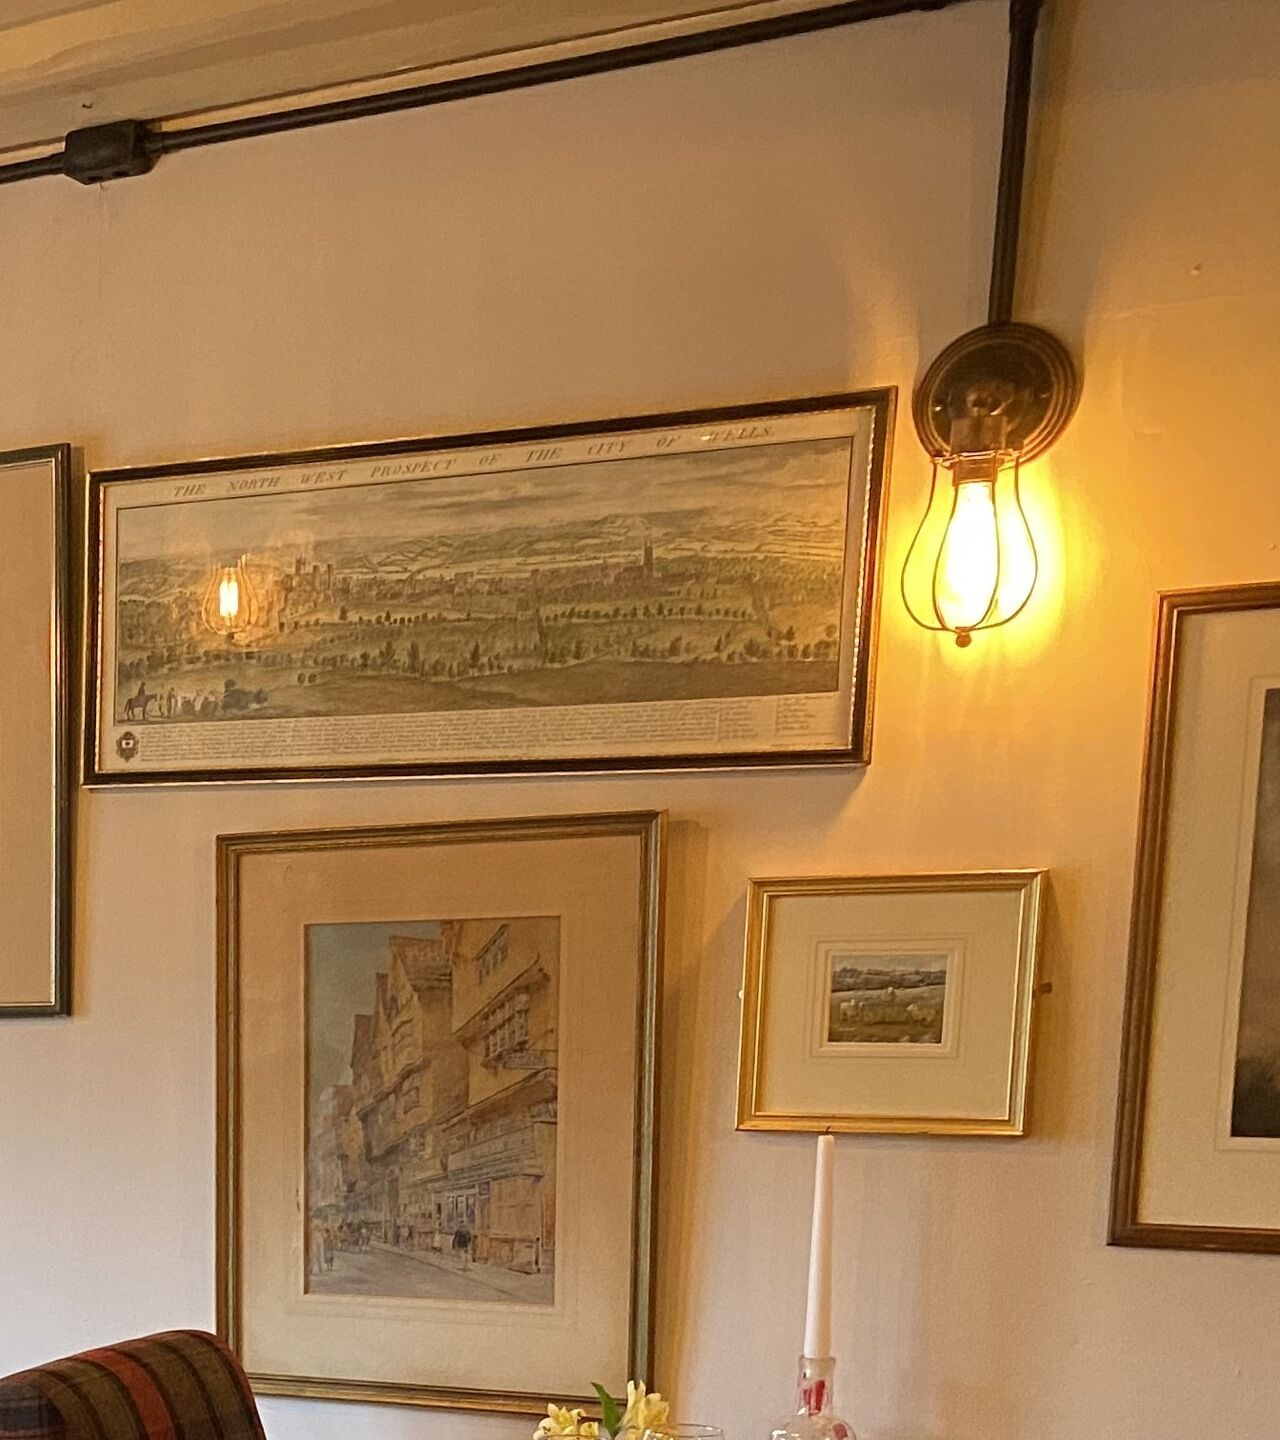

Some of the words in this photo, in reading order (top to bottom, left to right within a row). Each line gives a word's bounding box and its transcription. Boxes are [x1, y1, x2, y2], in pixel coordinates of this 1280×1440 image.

[173, 483, 207, 498] THE
[226, 475, 281, 492] NORTH
[300, 469, 348, 485] WEST
[370, 458, 458, 479] PROSPECT
[478, 453, 502, 467] OF
[524, 447, 561, 463] THE
[588, 440, 633, 456] CITY
[656, 435, 683, 449] OF
